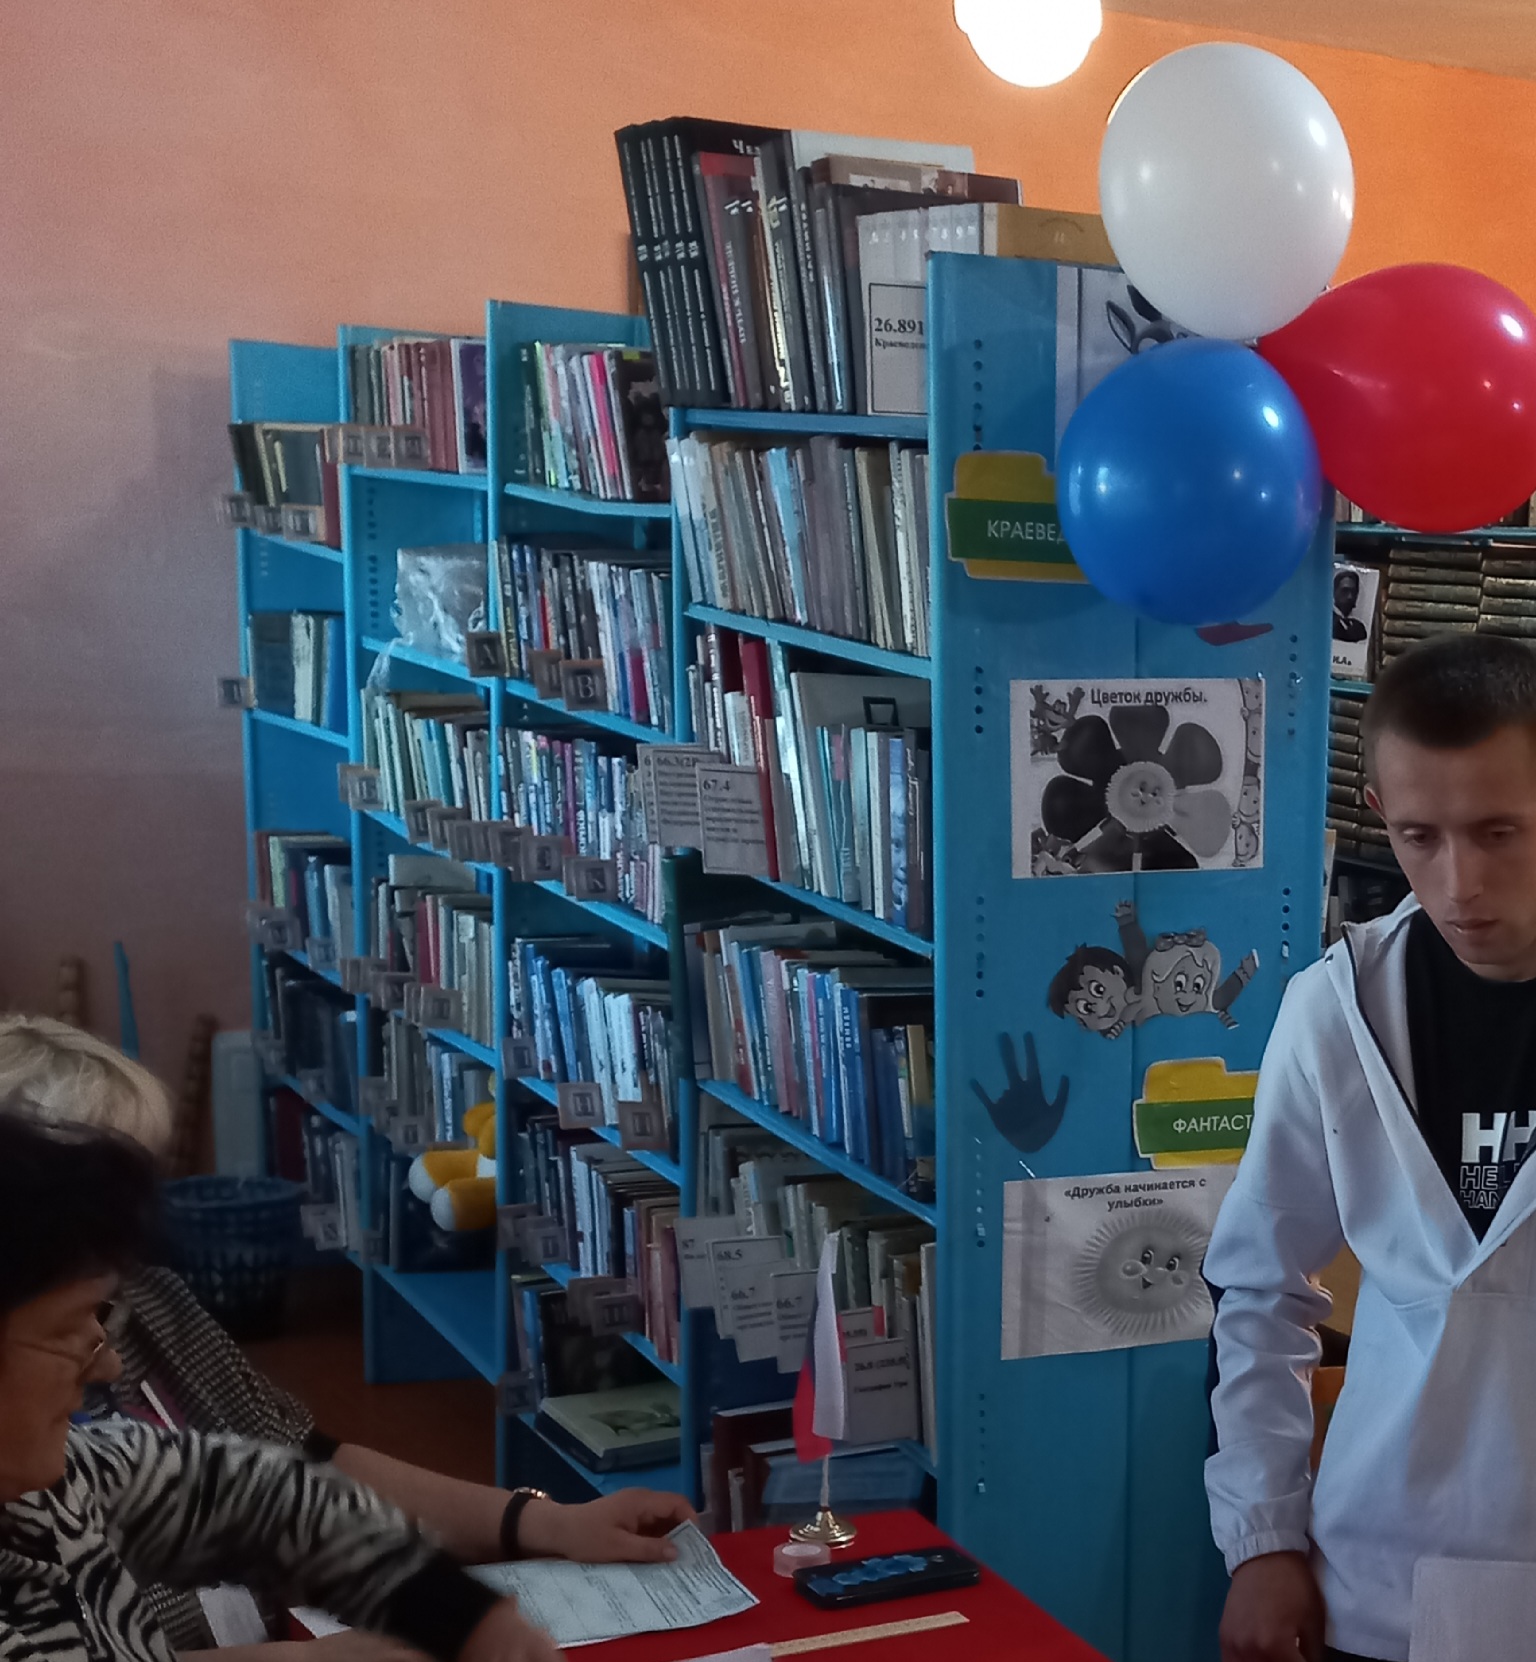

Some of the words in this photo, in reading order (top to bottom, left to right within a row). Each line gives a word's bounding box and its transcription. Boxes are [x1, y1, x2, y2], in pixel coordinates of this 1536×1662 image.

[1090, 687, 1141, 706] Цветок
[1144, 687, 1208, 708] дружбы.
[703, 779, 731, 791] 67.4
[1063, 1184, 1121, 1200] «Дружба
[1124, 1178, 1196, 1196] начинается
[1198, 1178, 1206, 1188] с
[1106, 1195, 1165, 1211] улыбки»
